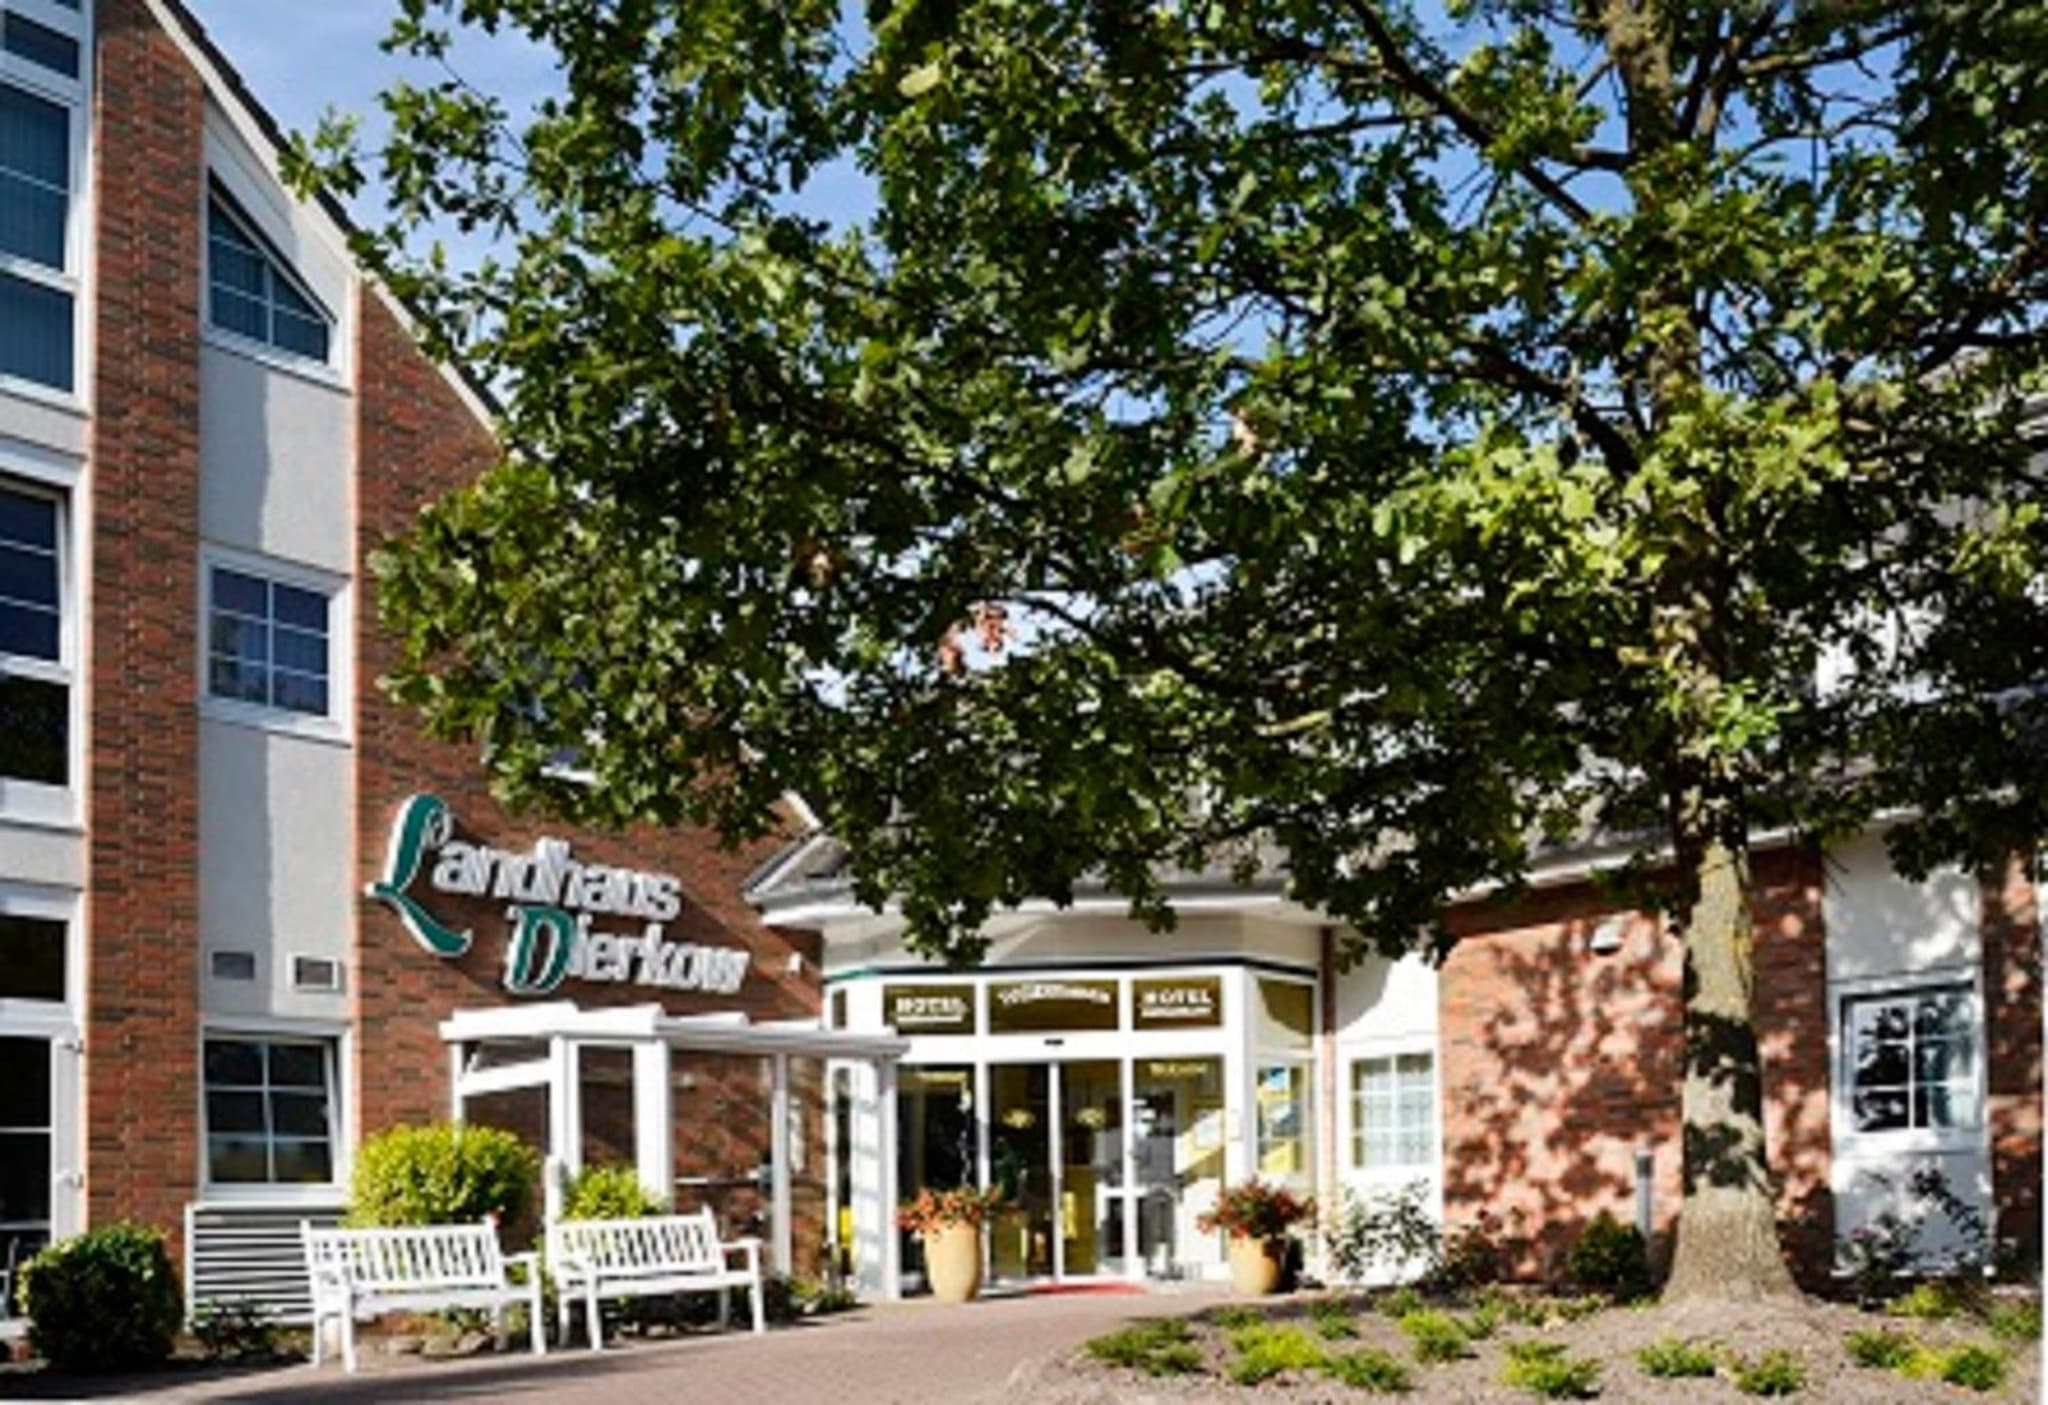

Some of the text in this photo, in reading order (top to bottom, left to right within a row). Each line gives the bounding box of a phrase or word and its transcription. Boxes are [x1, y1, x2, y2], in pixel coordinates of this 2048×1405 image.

[365, 794, 682, 957] Landhaus
[503, 902, 751, 994] Dierkow
[1142, 988, 1213, 1005] HOTEL
